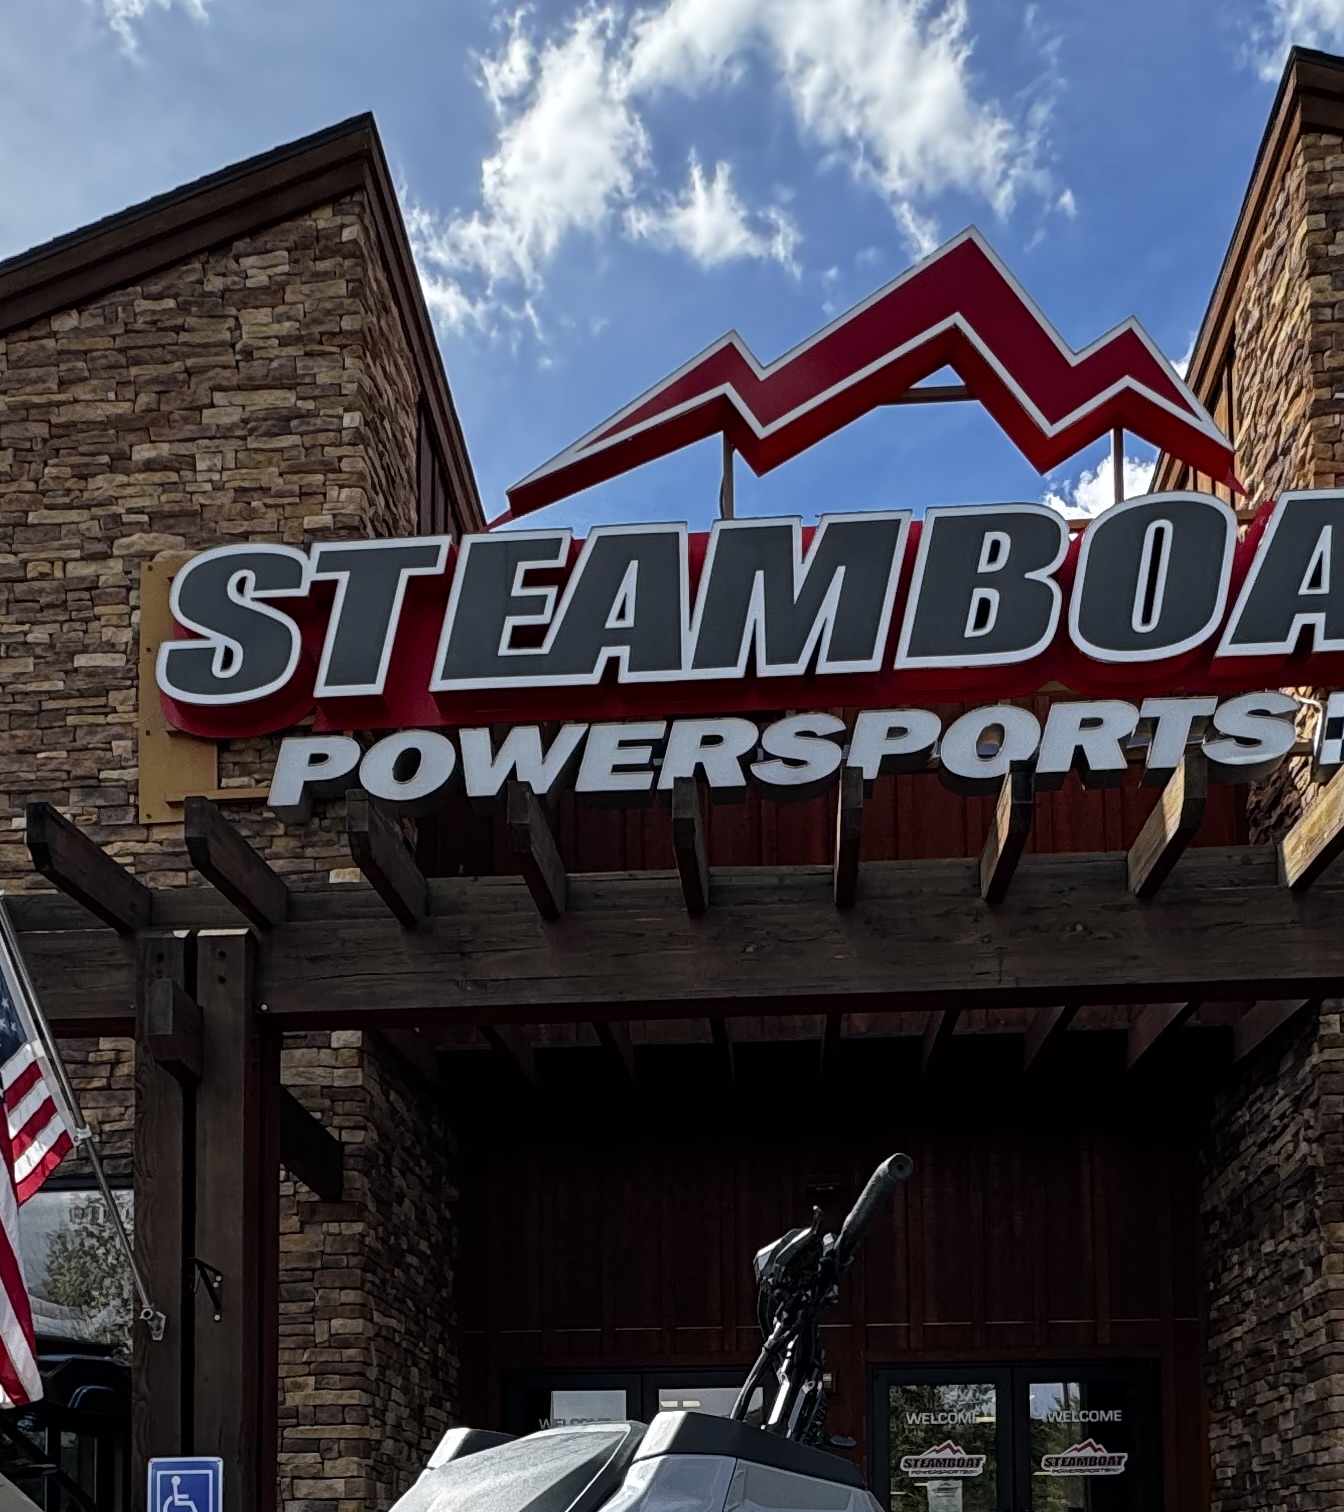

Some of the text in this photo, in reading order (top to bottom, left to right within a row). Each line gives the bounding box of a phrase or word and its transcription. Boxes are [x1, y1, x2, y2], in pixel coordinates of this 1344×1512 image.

[268, 692, 1297, 806] POWERSPORTS
[906, 1411, 980, 1425] WELCOME
[1048, 1410, 1123, 1422] WELCOME
[903, 1457, 984, 1469] STEAMBOAT
[1044, 1456, 1126, 1467] STEAMBOAT
